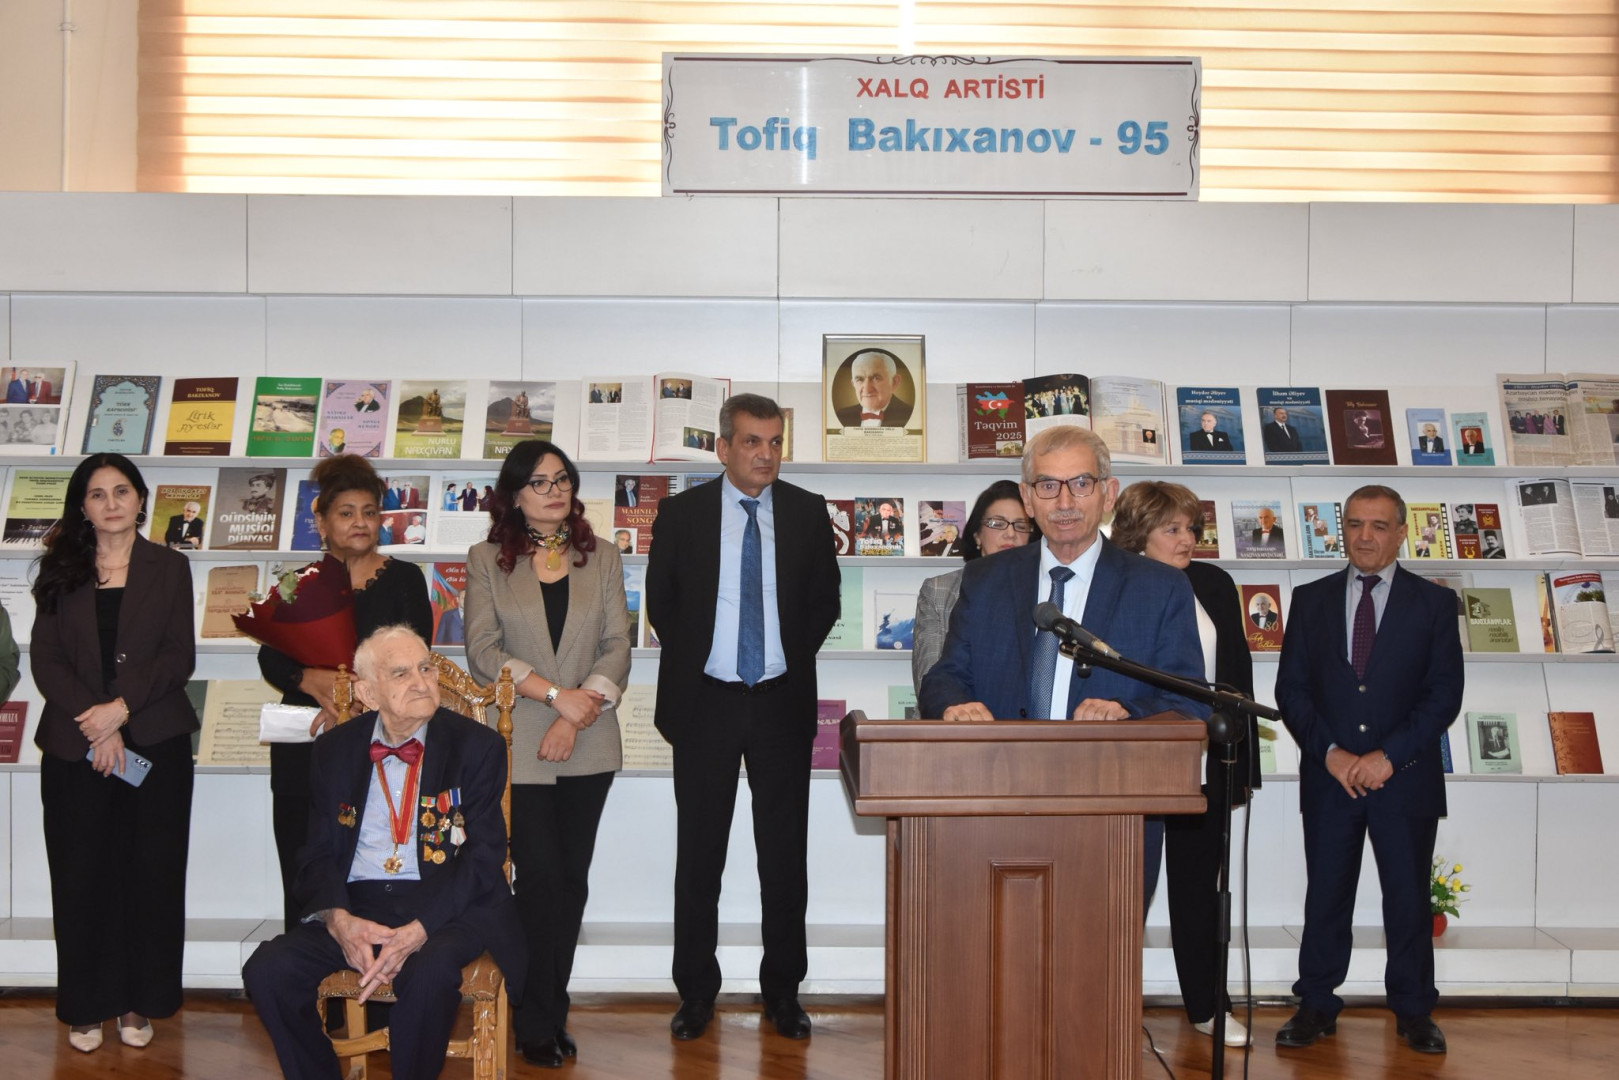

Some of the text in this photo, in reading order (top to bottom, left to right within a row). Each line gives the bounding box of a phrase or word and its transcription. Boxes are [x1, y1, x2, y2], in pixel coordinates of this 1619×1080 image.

[856, 74, 1045, 100] XALQ ARTİSTİ
[709, 116, 818, 161] Tofiq
[847, 116, 1076, 154] Bakıxanov
[1117, 120, 1170, 156] 95
[974, 420, 1018, 431] Təqvim
[996, 432, 1023, 440] 2025
[1265, 621, 1279, 632] 80
